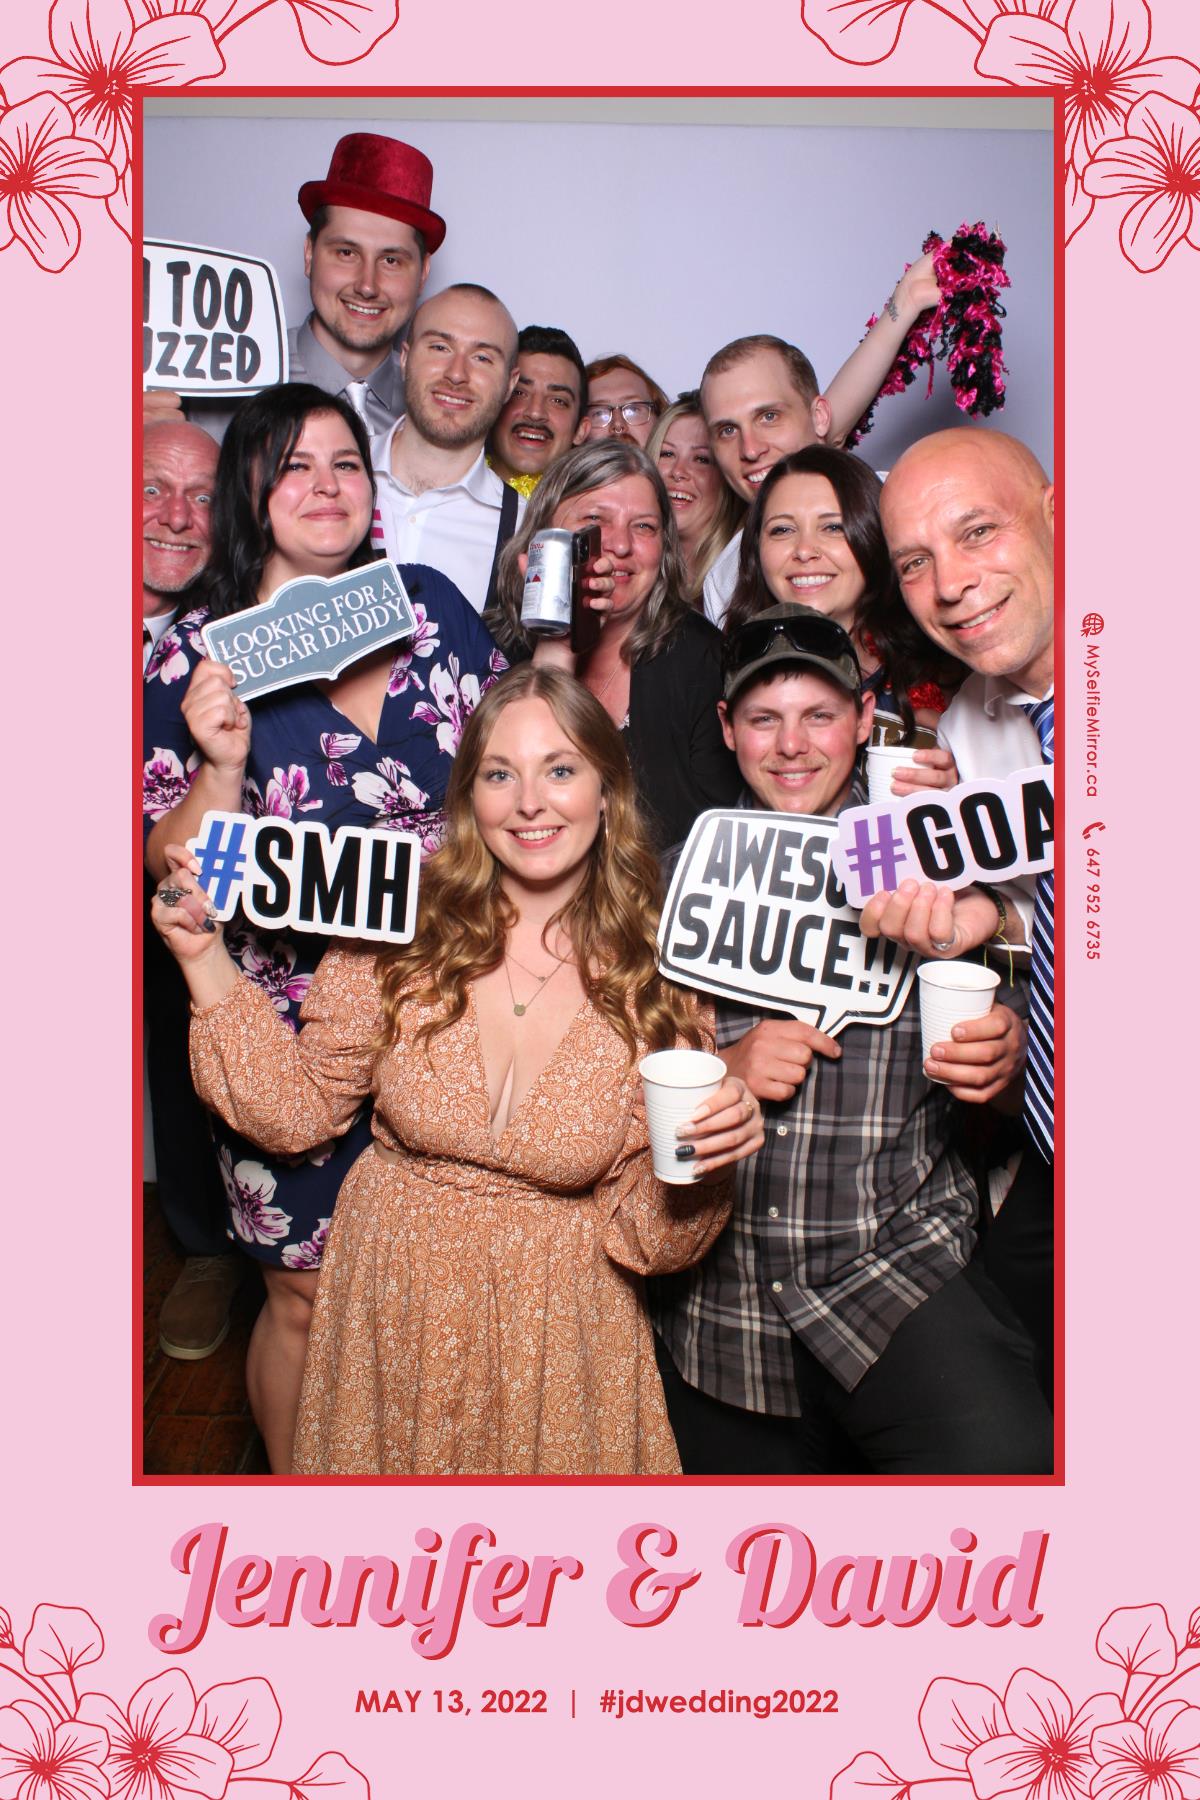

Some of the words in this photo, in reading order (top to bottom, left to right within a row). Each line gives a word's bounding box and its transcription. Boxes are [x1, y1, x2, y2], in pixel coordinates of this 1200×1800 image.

[166, 261, 253, 333] TOO
[218, 602, 331, 661] LOOKING
[333, 585, 377, 617] FOR
[382, 578, 397, 600] A
[229, 632, 320, 685] SUGAR
[318, 597, 404, 649] DADDY
[195, 820, 412, 933] #SMH
[672, 892, 898, 997] SAUCE!!
